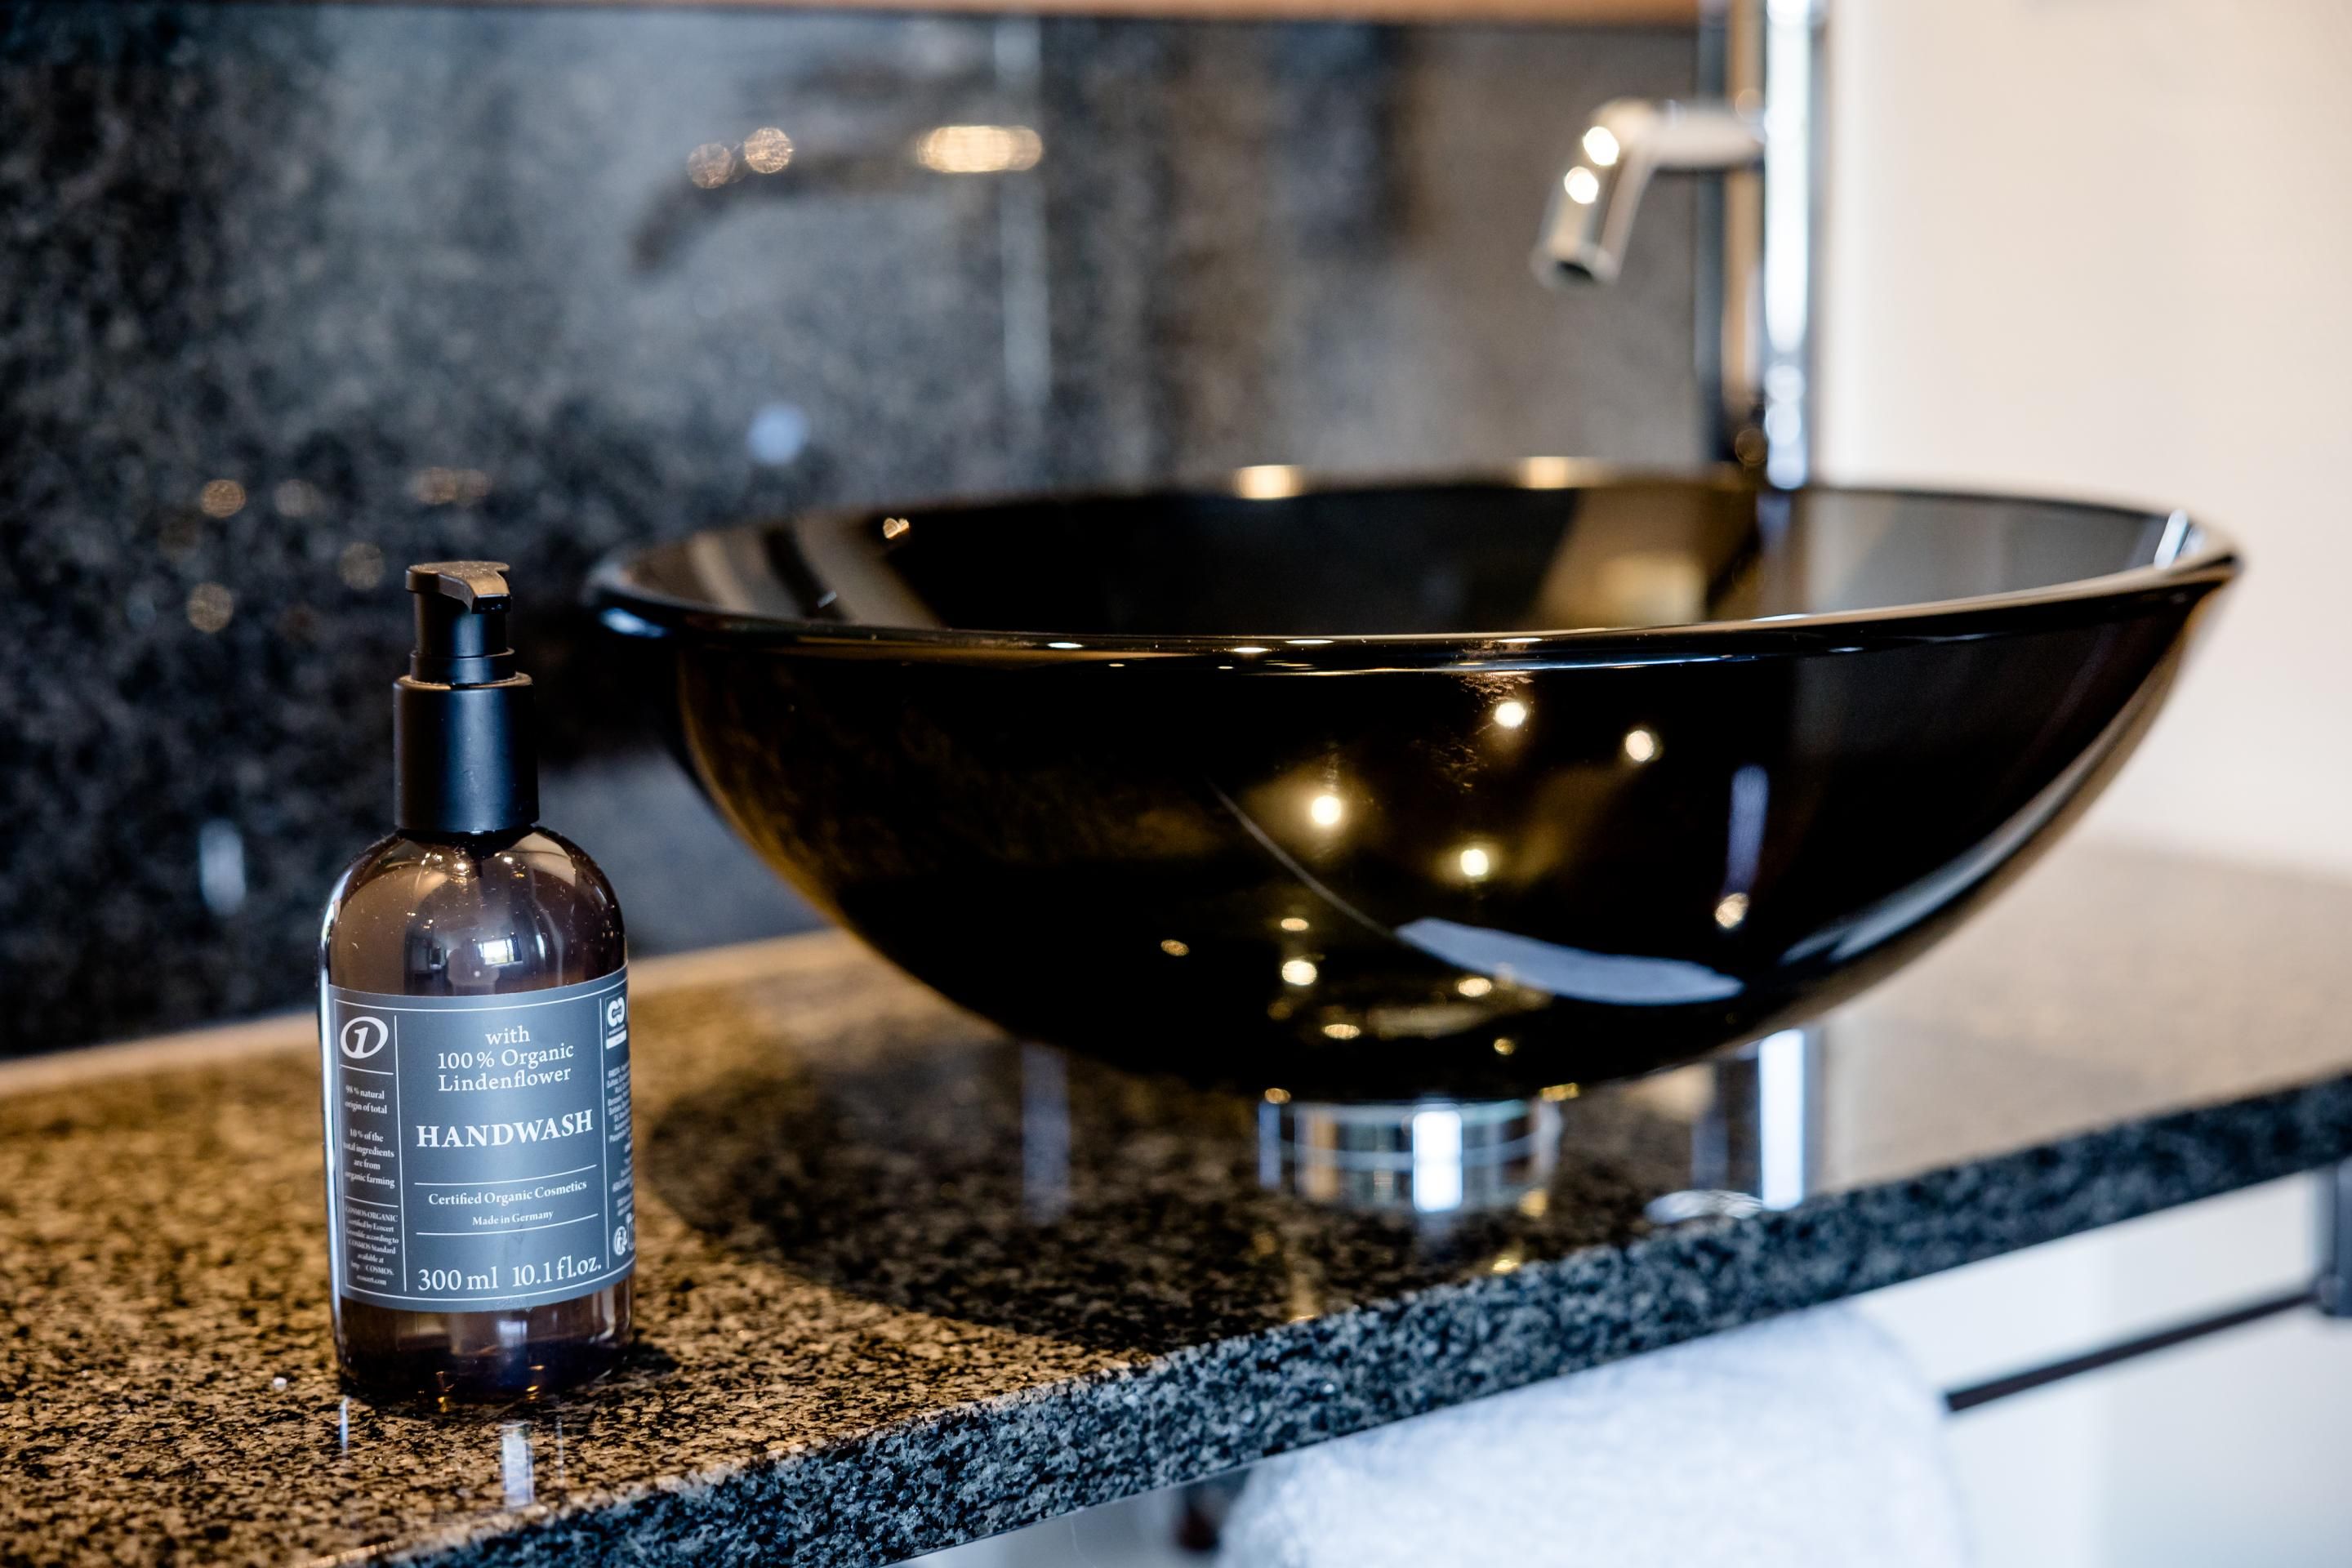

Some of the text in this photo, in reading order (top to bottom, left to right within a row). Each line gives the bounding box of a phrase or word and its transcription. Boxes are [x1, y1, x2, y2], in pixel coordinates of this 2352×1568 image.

[485, 1025, 531, 1045] with
[501, 1043, 574, 1069] Organic
[438, 1067, 572, 1091] Lindenflower
[360, 1090, 385, 1099] natural
[363, 1102, 370, 1111] of
[371, 1104, 387, 1114] total
[416, 1108, 594, 1147] HANDWASH
[364, 1131, 372, 1140] of
[372, 1132, 384, 1143] the
[356, 1144, 394, 1157] ingredients
[363, 1158, 381, 1169] from
[367, 1174, 395, 1189] farming
[428, 1180, 587, 1206] Certified Organic Cosmetics
[367, 1211, 399, 1222] ORGANIC
[472, 1209, 554, 1226] Made in Germany
[371, 1244, 396, 1254] Standard
[417, 1268, 462, 1290] 300
[466, 1266, 499, 1290] ml
[512, 1262, 553, 1287] 10.1
